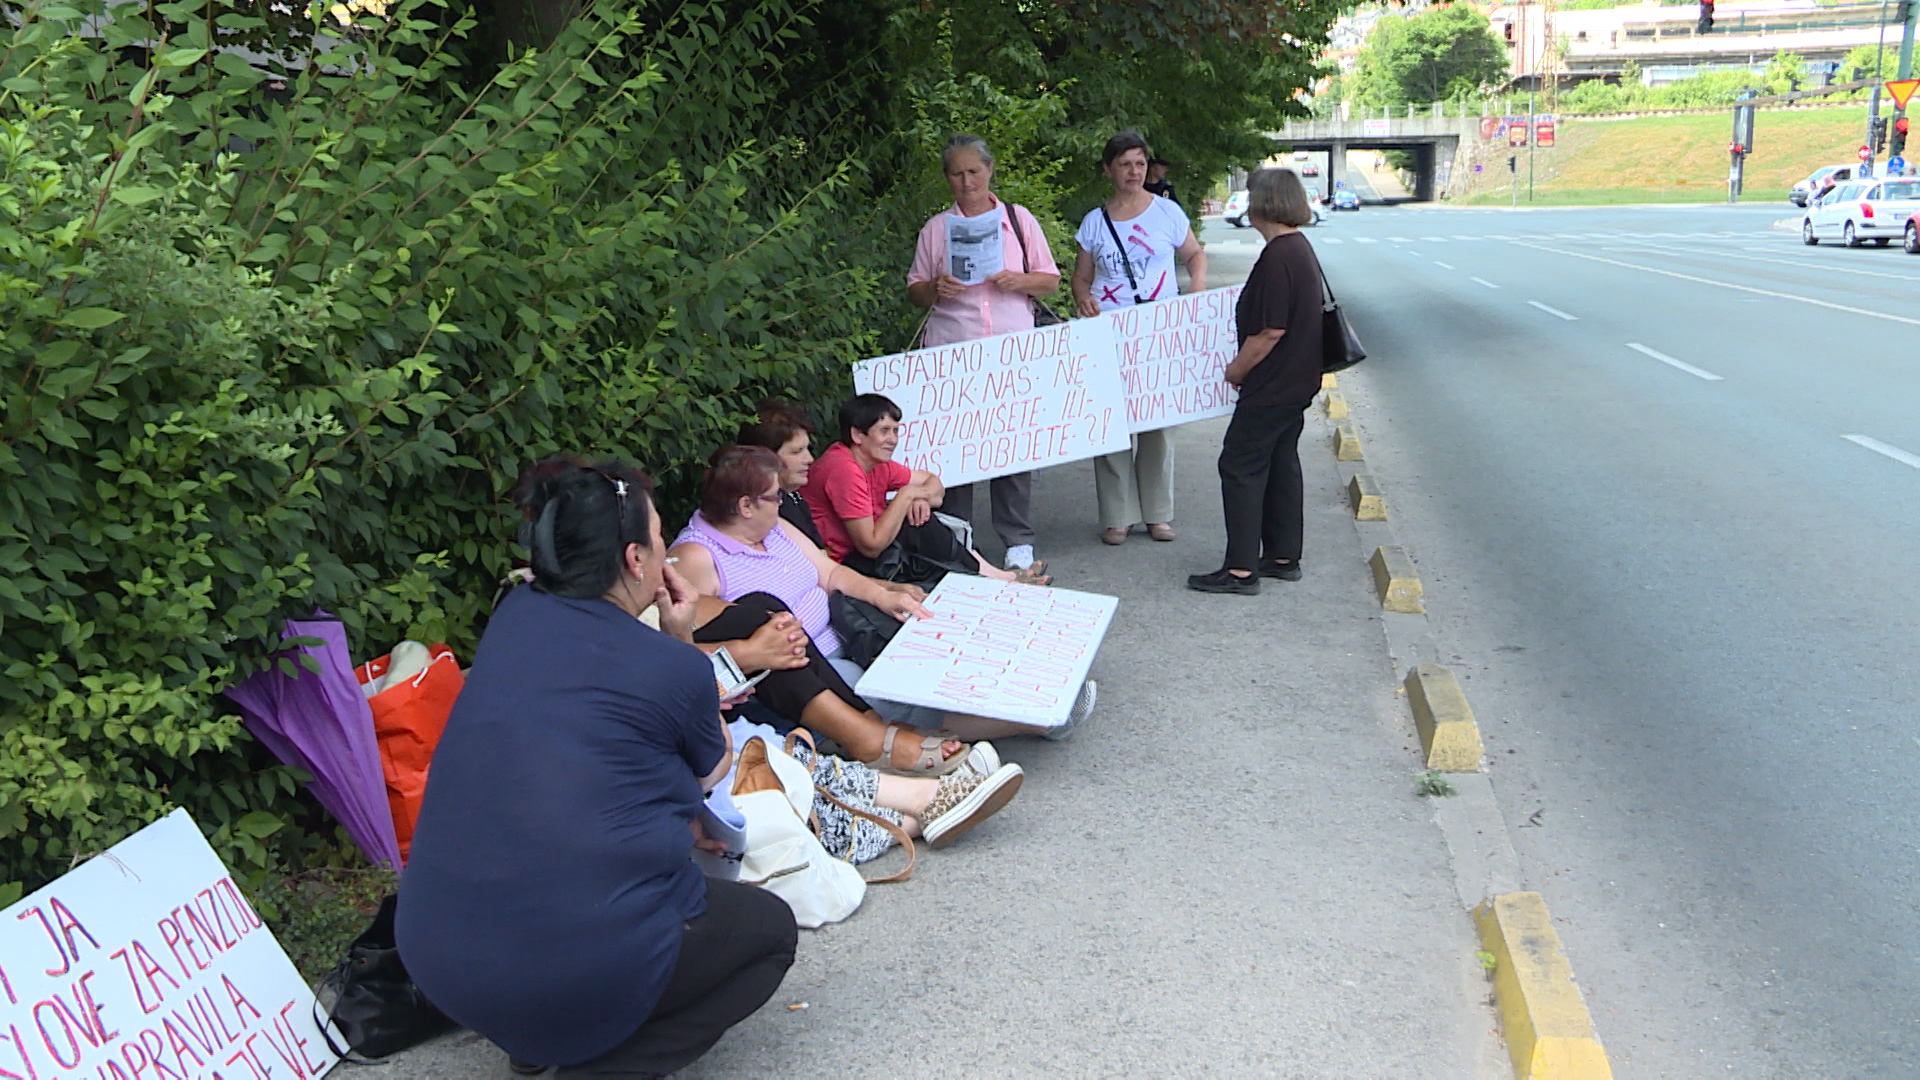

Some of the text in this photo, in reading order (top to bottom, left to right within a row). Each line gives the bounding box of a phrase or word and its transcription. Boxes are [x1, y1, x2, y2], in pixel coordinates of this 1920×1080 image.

[872, 325, 1072, 393] OSTAJEMO OVDJE
[918, 353, 1088, 416] DOK NAS NE
[961, 423, 1072, 475] POBIJETE
[16, 896, 101, 976] JA
[109, 939, 180, 1014] ZA
[157, 877, 262, 979] PENZIJU
[81, 973, 261, 1080] PRAVILA
